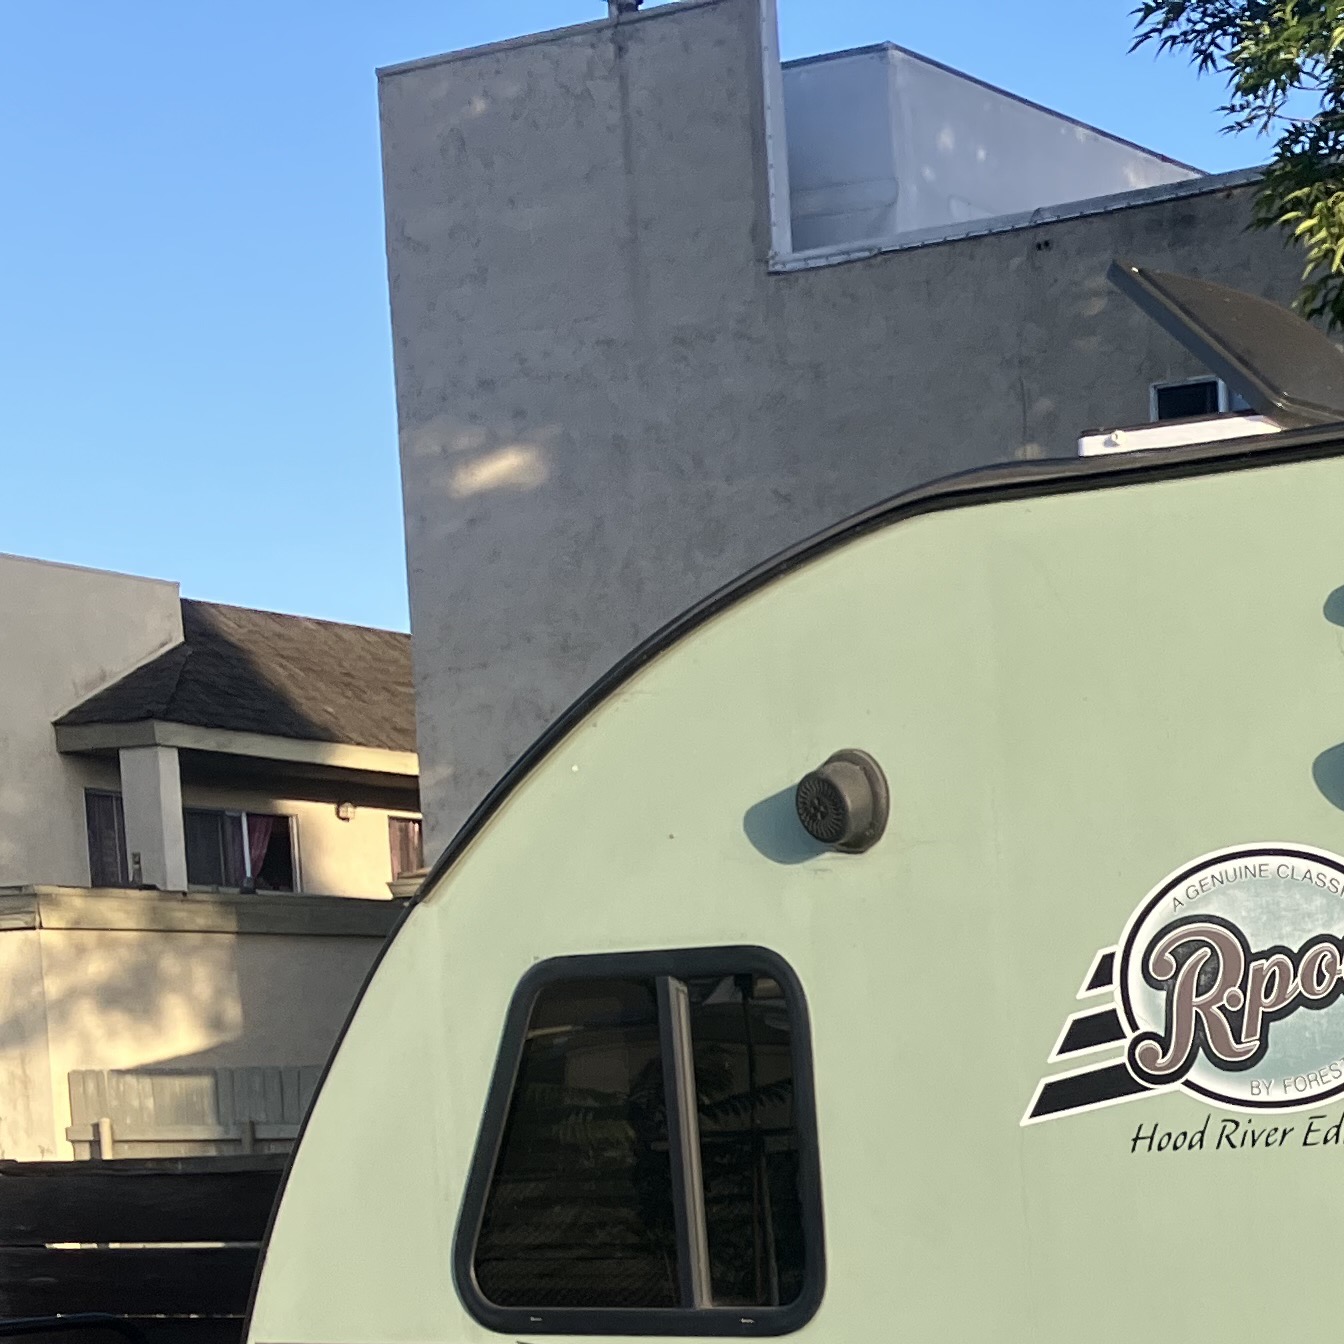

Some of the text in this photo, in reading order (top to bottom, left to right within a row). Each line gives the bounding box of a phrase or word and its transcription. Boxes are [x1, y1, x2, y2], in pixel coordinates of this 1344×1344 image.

[1170, 896, 1184, 912] A
[1185, 863, 1270, 900] GENUINE
[1250, 1078, 1275, 1096] BY
[1131, 1113, 1211, 1153] Hood
[1215, 1118, 1295, 1150] River
